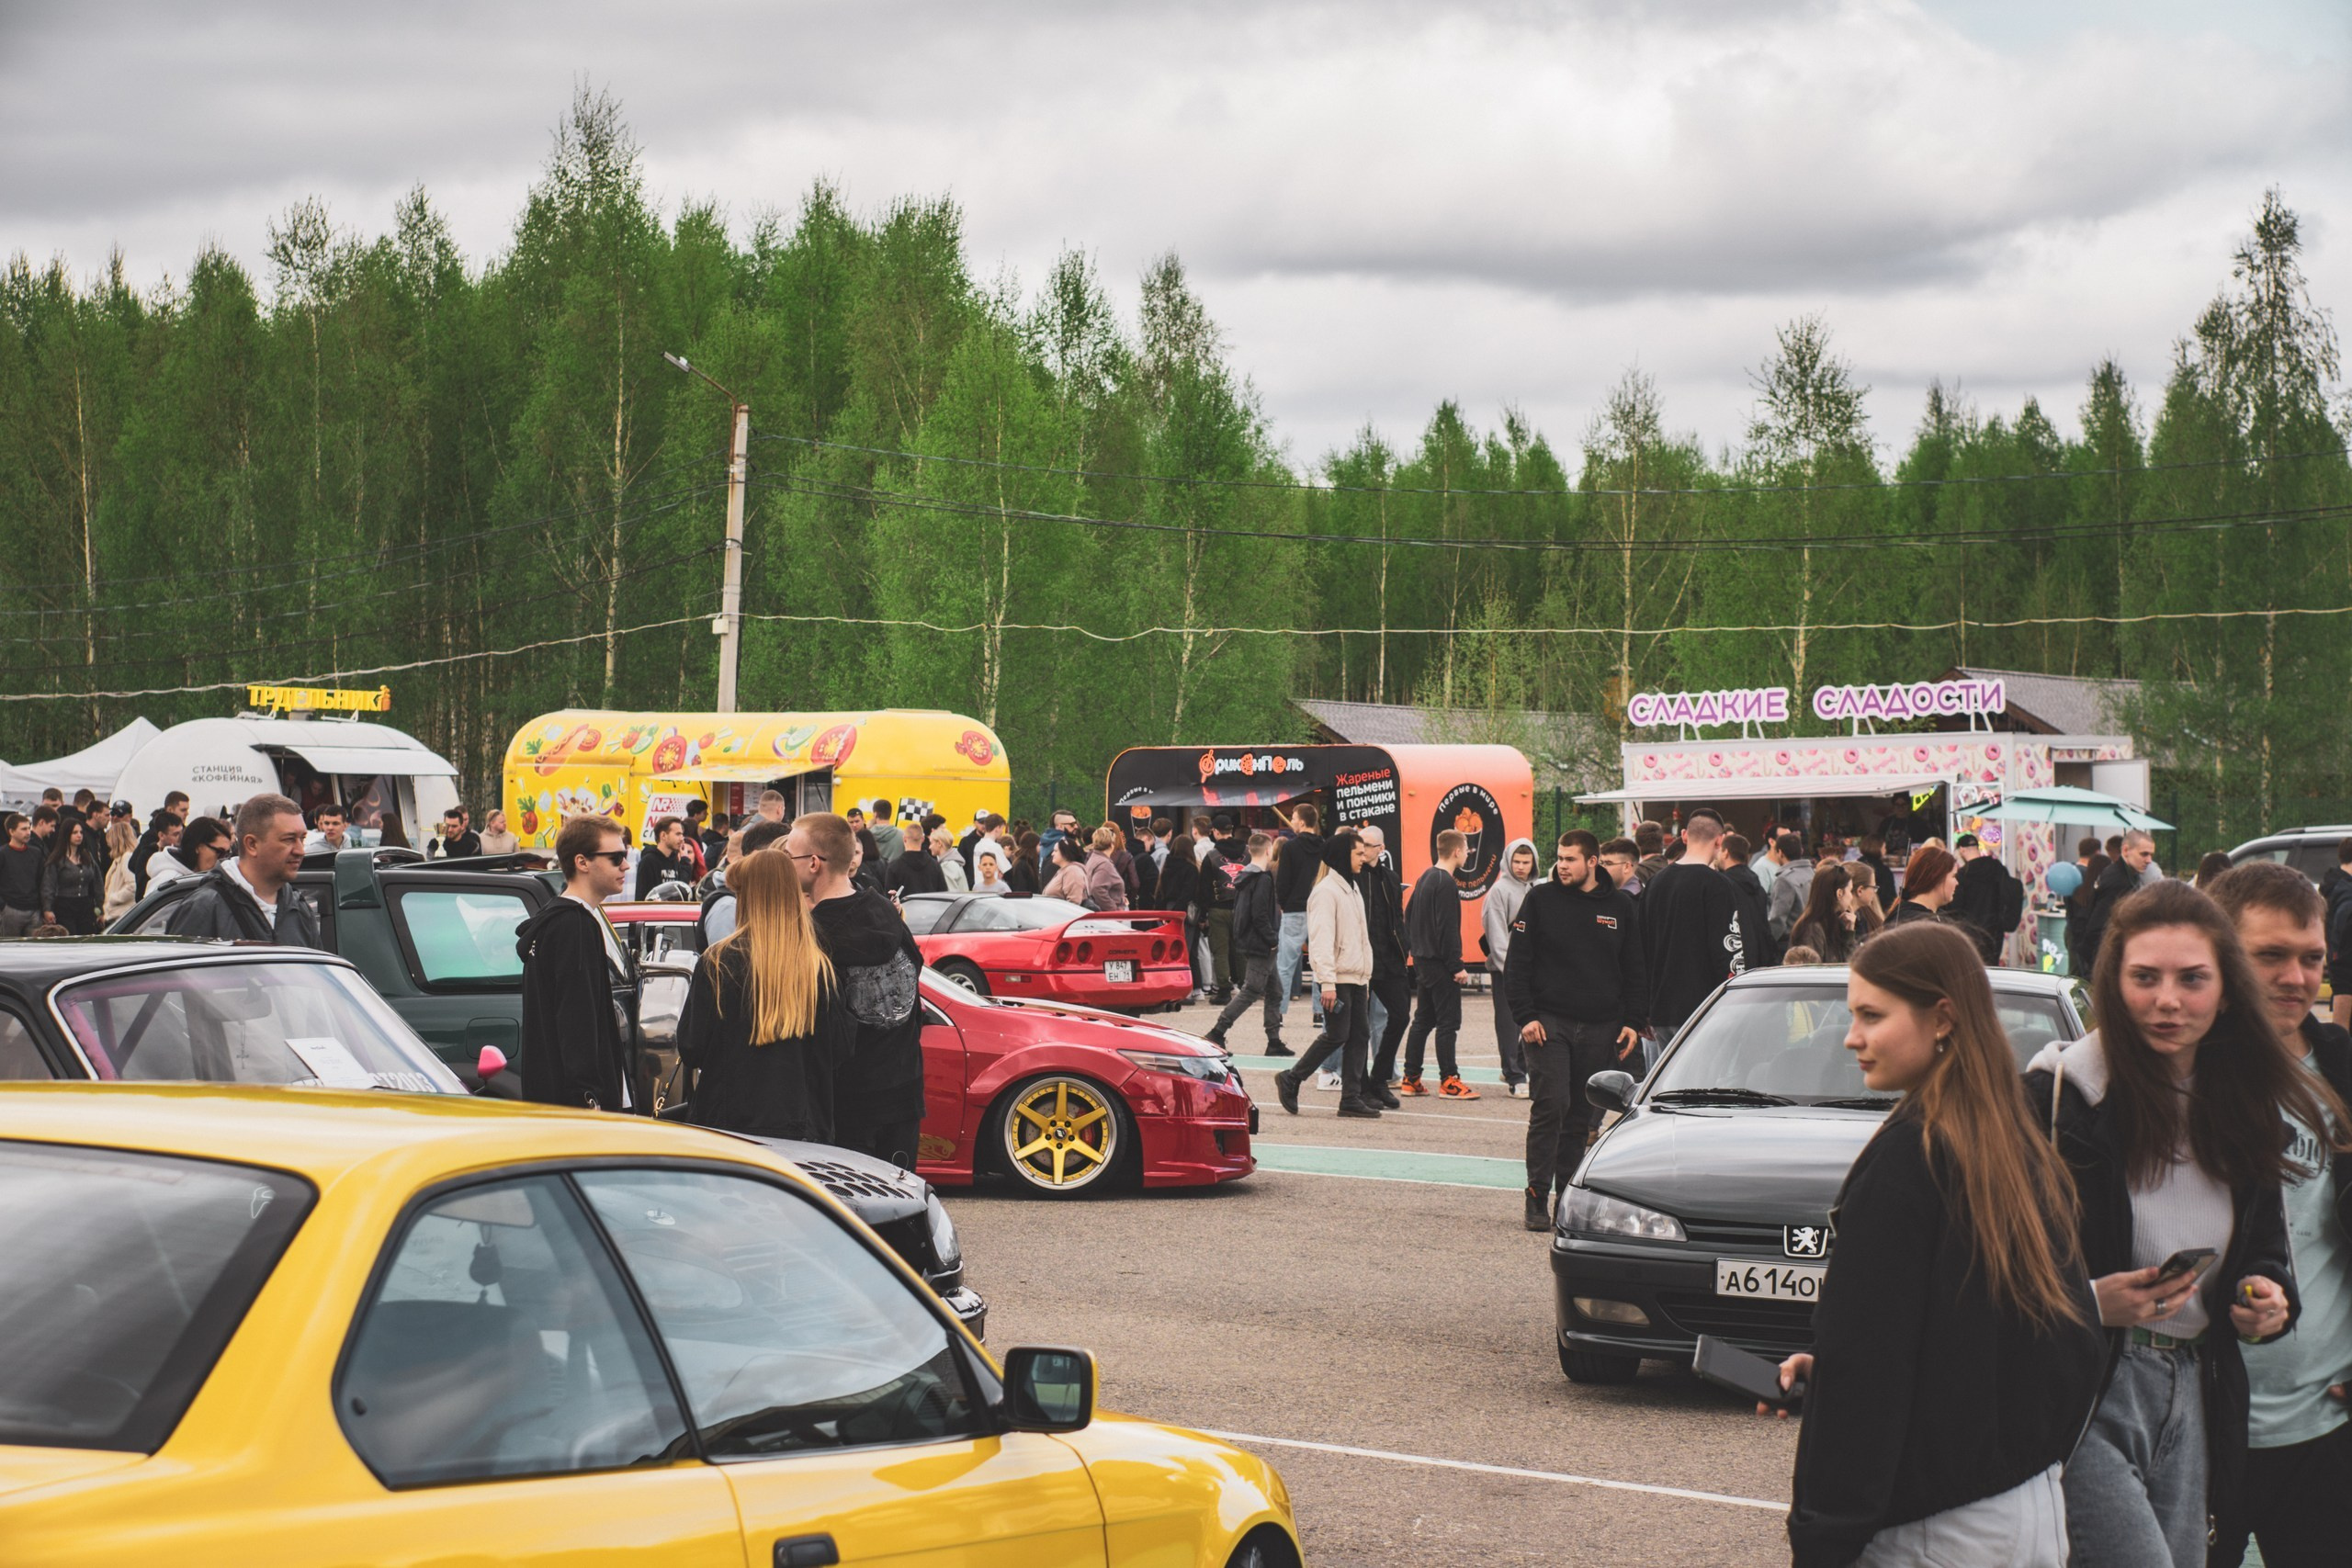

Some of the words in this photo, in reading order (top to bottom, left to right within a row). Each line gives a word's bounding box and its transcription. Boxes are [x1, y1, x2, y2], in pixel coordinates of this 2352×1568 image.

[1630, 690, 1786, 724] СЛАДКИЕ
[1814, 682, 2003, 717] СЛАДОСТИ
[191, 773, 264, 784] «КОФЕЙНАЯ»
[192, 764, 243, 774] СТАНЦИЯ
[1335, 768, 1391, 786] Жареные
[1336, 779, 1394, 799] пельмени
[1336, 800, 1345, 810] и
[1346, 791, 1396, 809] пончики
[1438, 784, 1471, 814] Первые
[1479, 789, 1498, 815] мире
[1339, 812, 1347, 822] в
[1348, 803, 1396, 820] стакане
